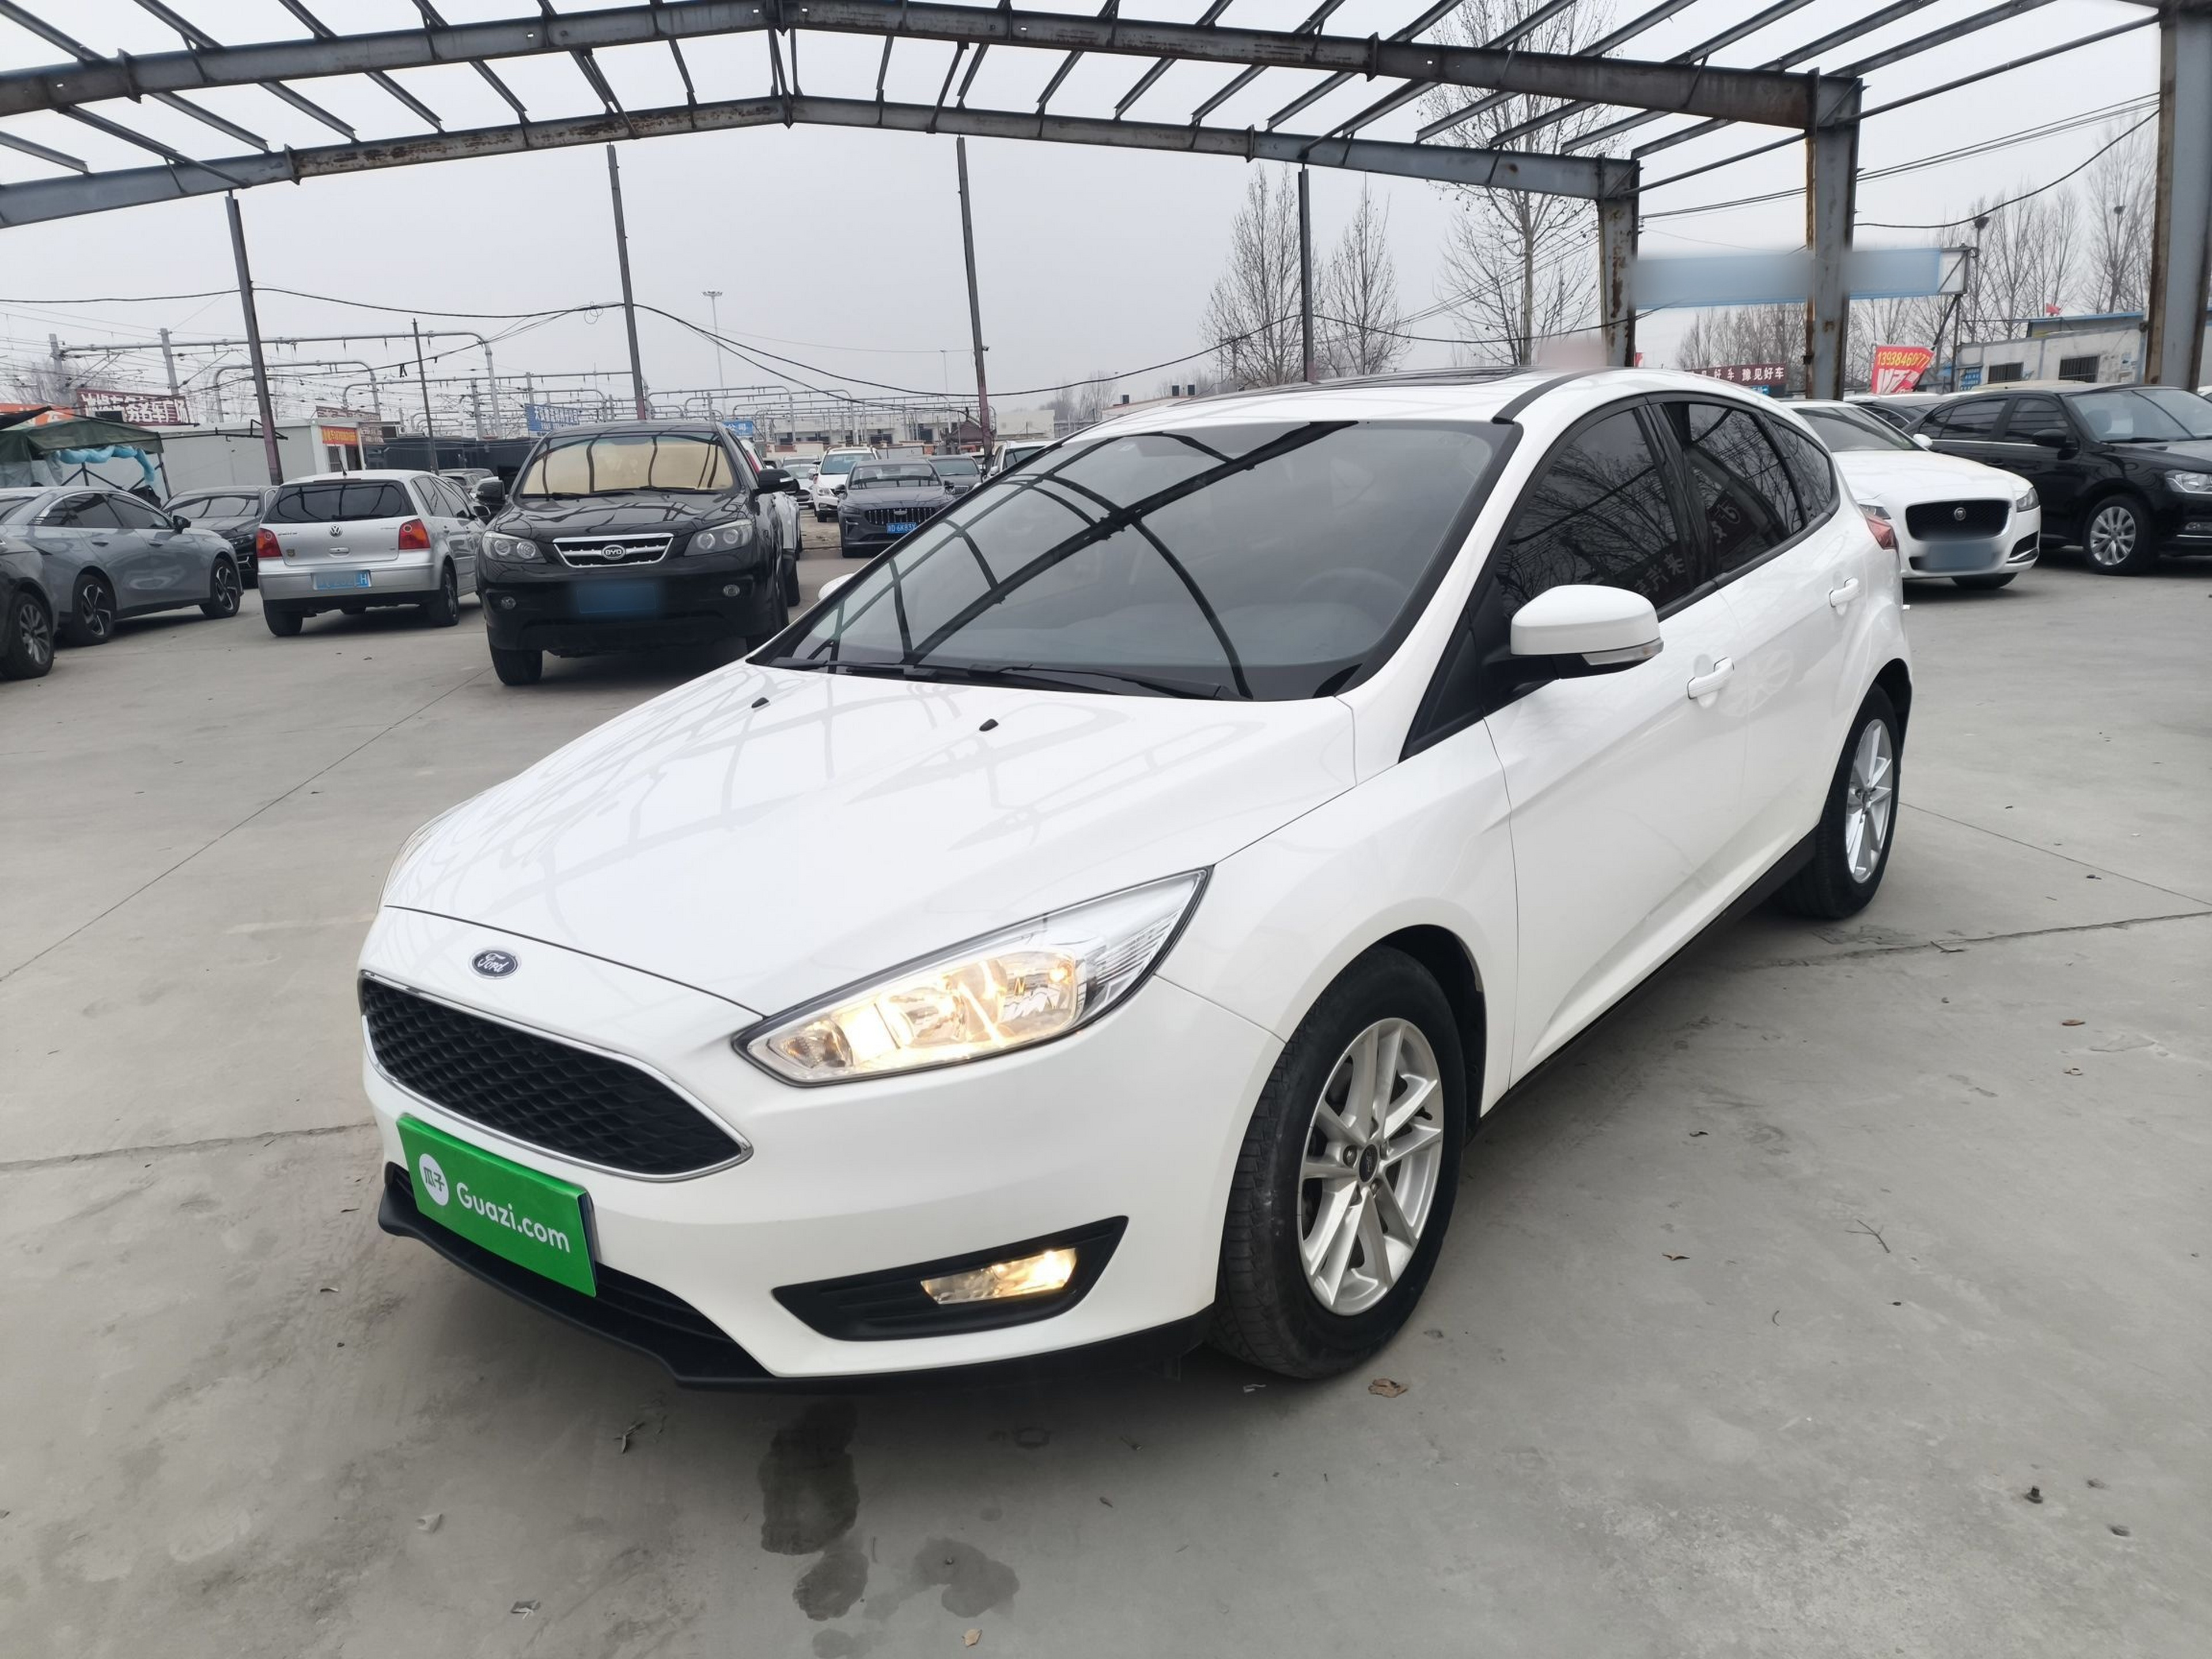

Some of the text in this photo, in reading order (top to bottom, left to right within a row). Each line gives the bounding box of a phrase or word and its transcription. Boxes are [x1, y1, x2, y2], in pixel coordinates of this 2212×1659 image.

[1742, 367, 1784, 381] 豫见好车
[478, 952, 509, 972] Ford
[423, 1166, 570, 1253] 瓜子 Guazi.com
